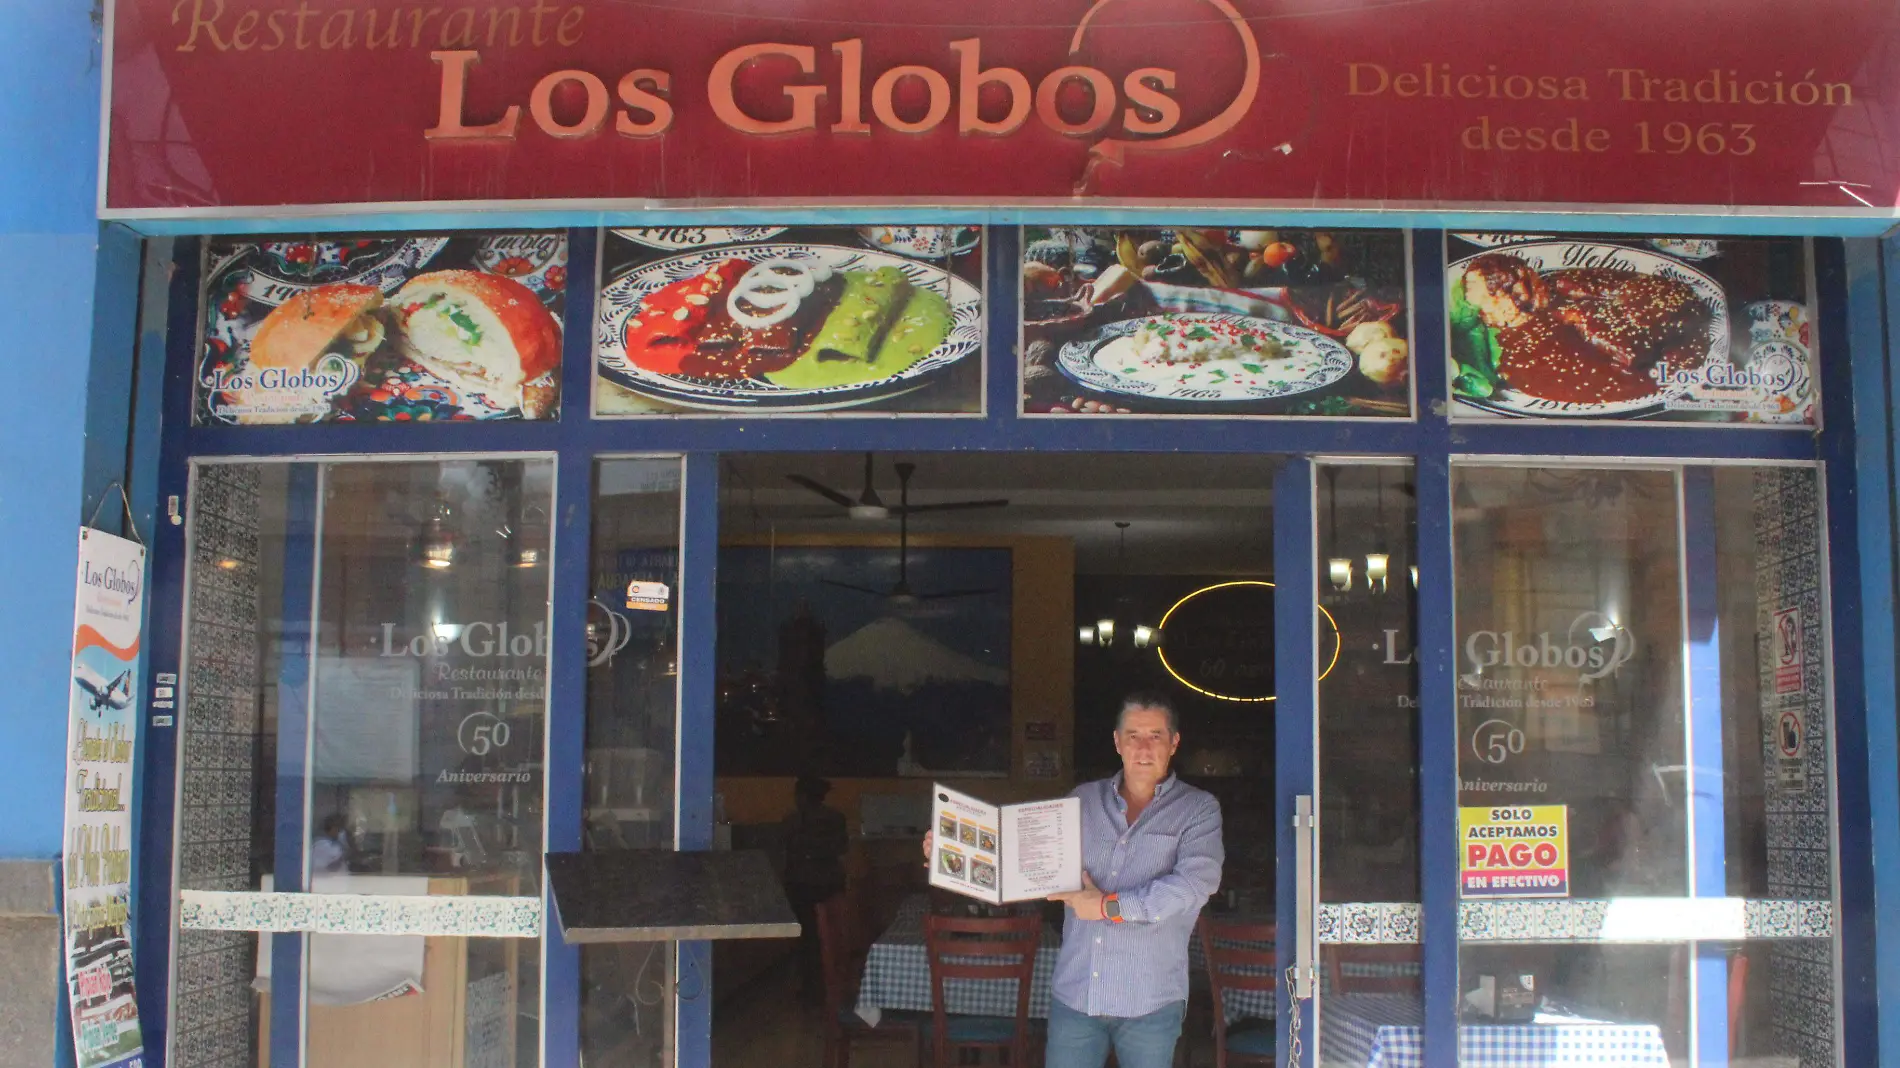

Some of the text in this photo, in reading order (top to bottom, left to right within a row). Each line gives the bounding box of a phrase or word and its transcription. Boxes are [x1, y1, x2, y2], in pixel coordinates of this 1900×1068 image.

[172, 0, 585, 53] Restaurante
[424, 37, 1182, 140] Los Globos
[1345, 62, 1854, 108] Deliciosa Tradición
[1461, 115, 1757, 156] desde 1963
[214, 368, 338, 390] Los Globos
[1657, 362, 1788, 386] Los Globos
[84, 560, 137, 598] Los Globos
[631, 596, 666, 605] CENSADO
[380, 622, 450, 658] Los
[1465, 630, 1605, 668] Globos
[435, 663, 543, 682] Restaurante
[390, 687, 449, 701] Deliciosa
[450, 686, 512, 701] Tradición
[1459, 694, 1523, 709] Tradición
[1526, 694, 1562, 709] desde
[471, 721, 511, 756] 50
[1487, 728, 1526, 764] 50
[437, 768, 531, 784] Aniversario
[1491, 808, 1533, 821] SOLO
[1468, 825, 1558, 838] ACEPTAMOS
[1467, 842, 1558, 868] PAGO
[1467, 874, 1560, 889] EN EFECTIVO
